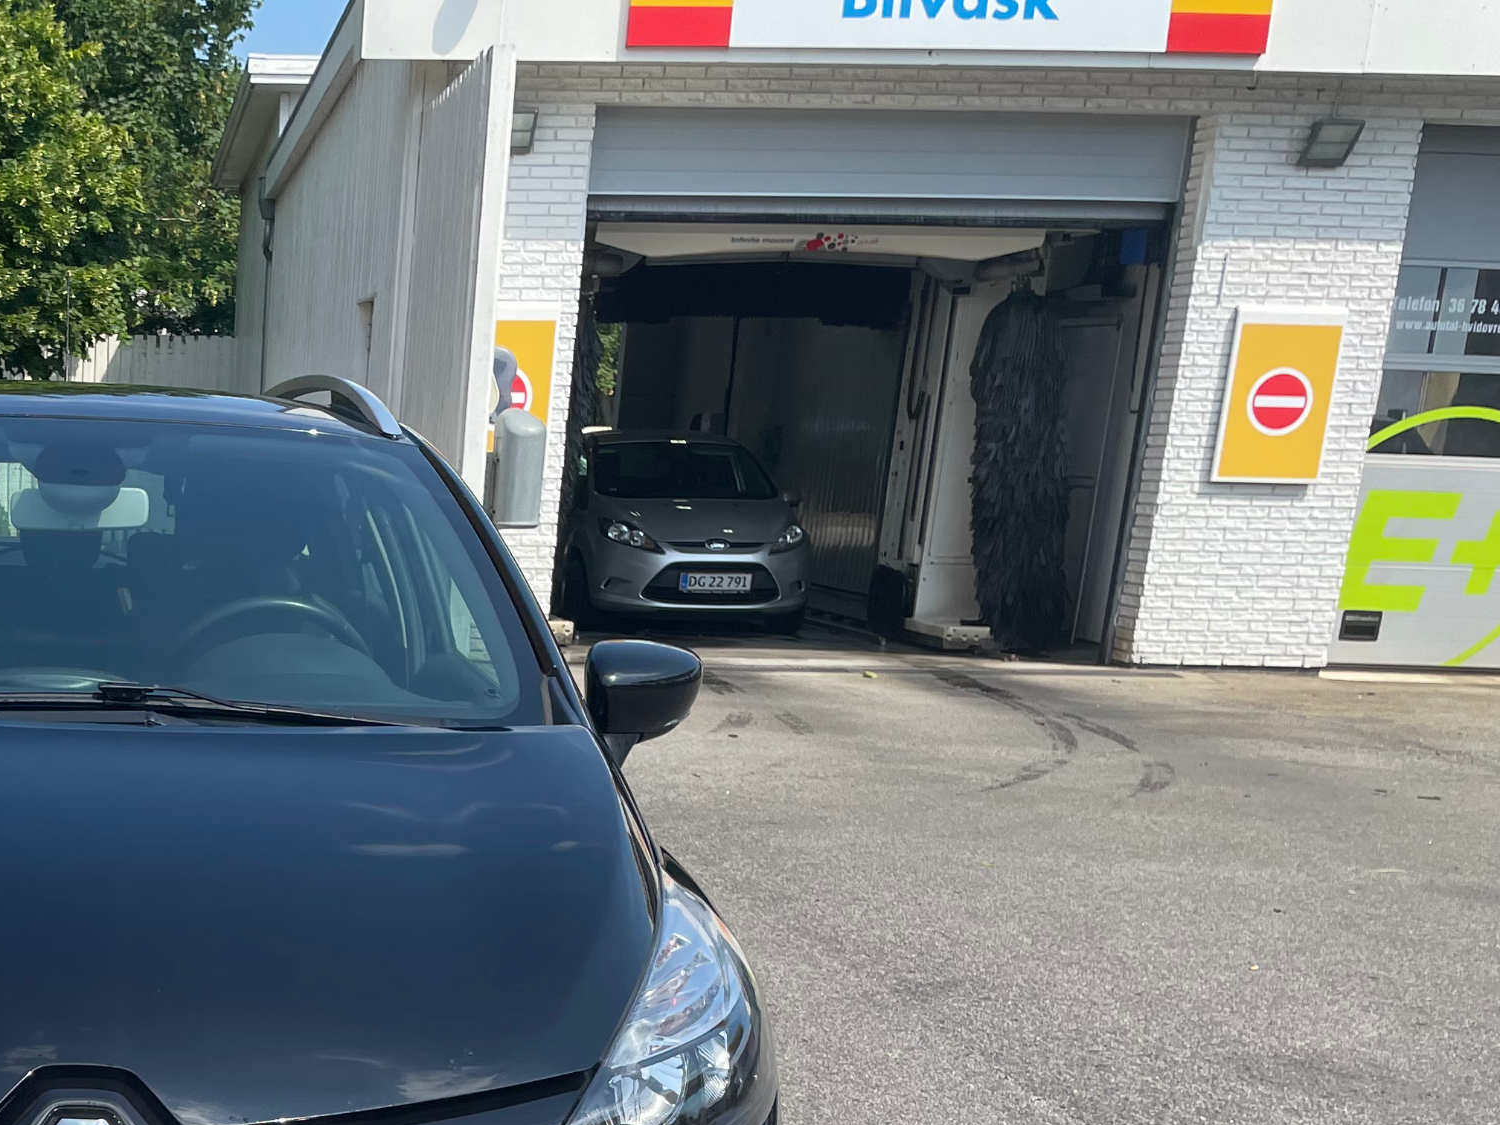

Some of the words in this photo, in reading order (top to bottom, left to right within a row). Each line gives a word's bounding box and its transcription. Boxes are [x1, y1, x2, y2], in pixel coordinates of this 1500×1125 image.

[1470, 299, 1487, 315] 78
[688, 575, 707, 588] DG
[708, 576, 724, 588] 22
[726, 576, 747, 588] 791
